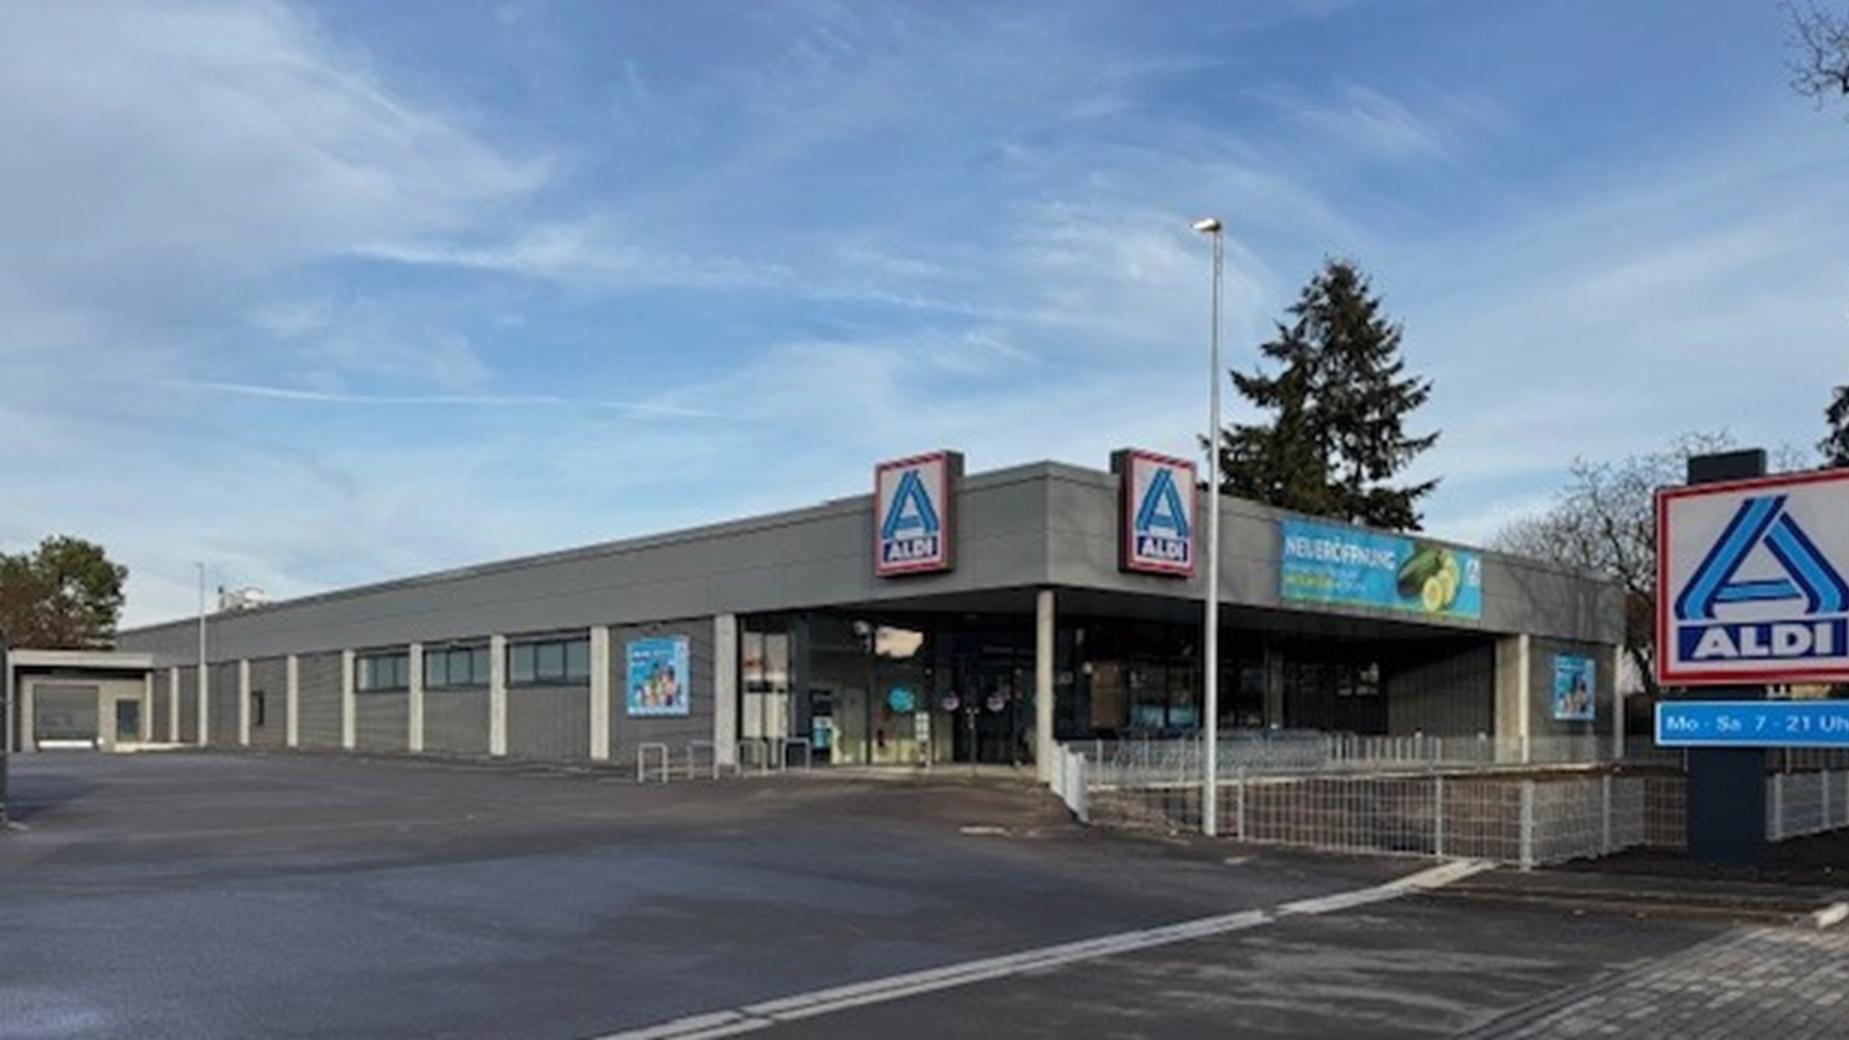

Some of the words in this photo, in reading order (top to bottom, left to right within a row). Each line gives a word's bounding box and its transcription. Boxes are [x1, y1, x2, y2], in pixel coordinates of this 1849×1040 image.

[888, 540, 933, 561] ALDI
[1142, 537, 1184, 559] ALDI
[1693, 624, 1832, 657] ALDI
[1666, 714, 1699, 732] Mo
[1716, 714, 1741, 732] Sa
[1755, 714, 1767, 732] 7
[1785, 714, 1810, 732] 21
